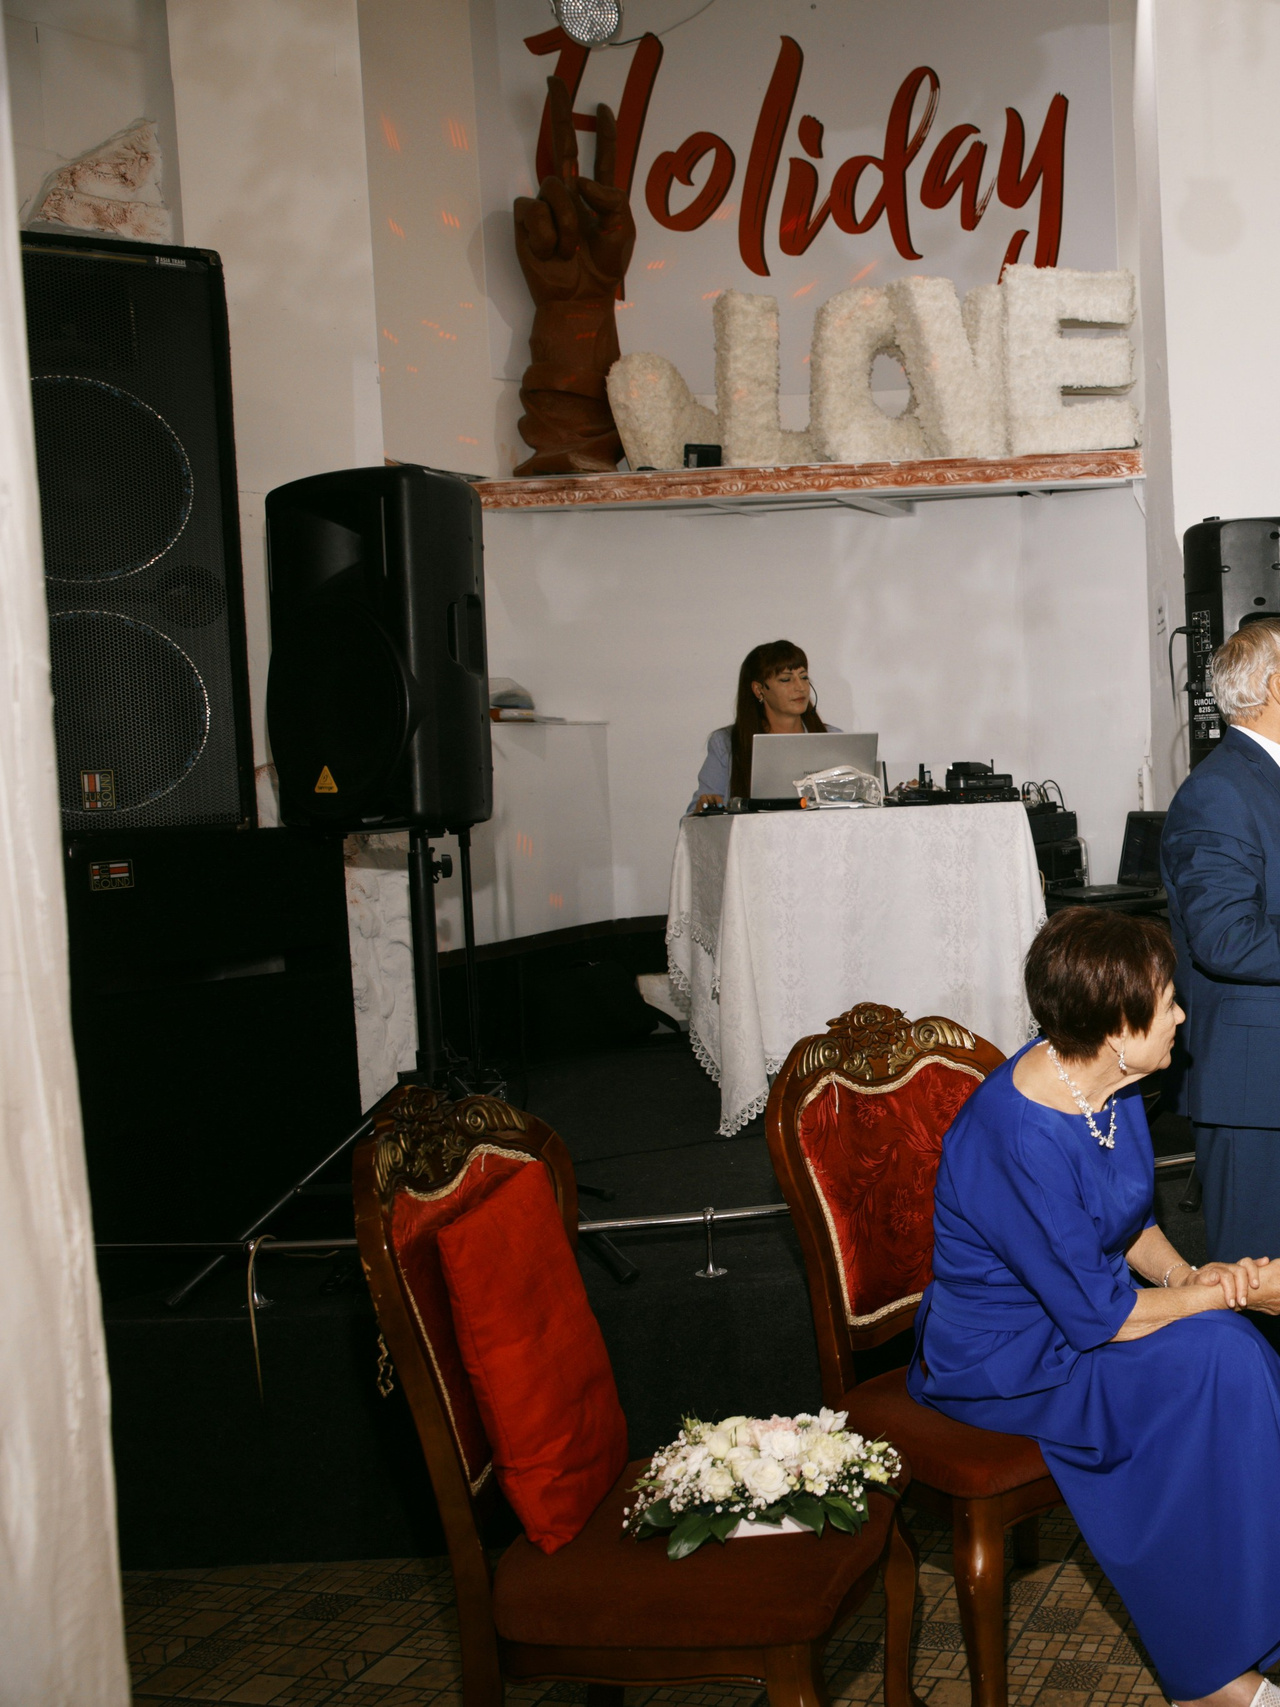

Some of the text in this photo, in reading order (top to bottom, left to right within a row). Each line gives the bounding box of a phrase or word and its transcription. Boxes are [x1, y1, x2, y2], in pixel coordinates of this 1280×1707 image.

[523, 26, 1070, 301] Holiday
[1194, 698, 1217, 706] EUROLIV
[101, 773, 112, 807] SOUND
[94, 877, 130, 889] SOUND
